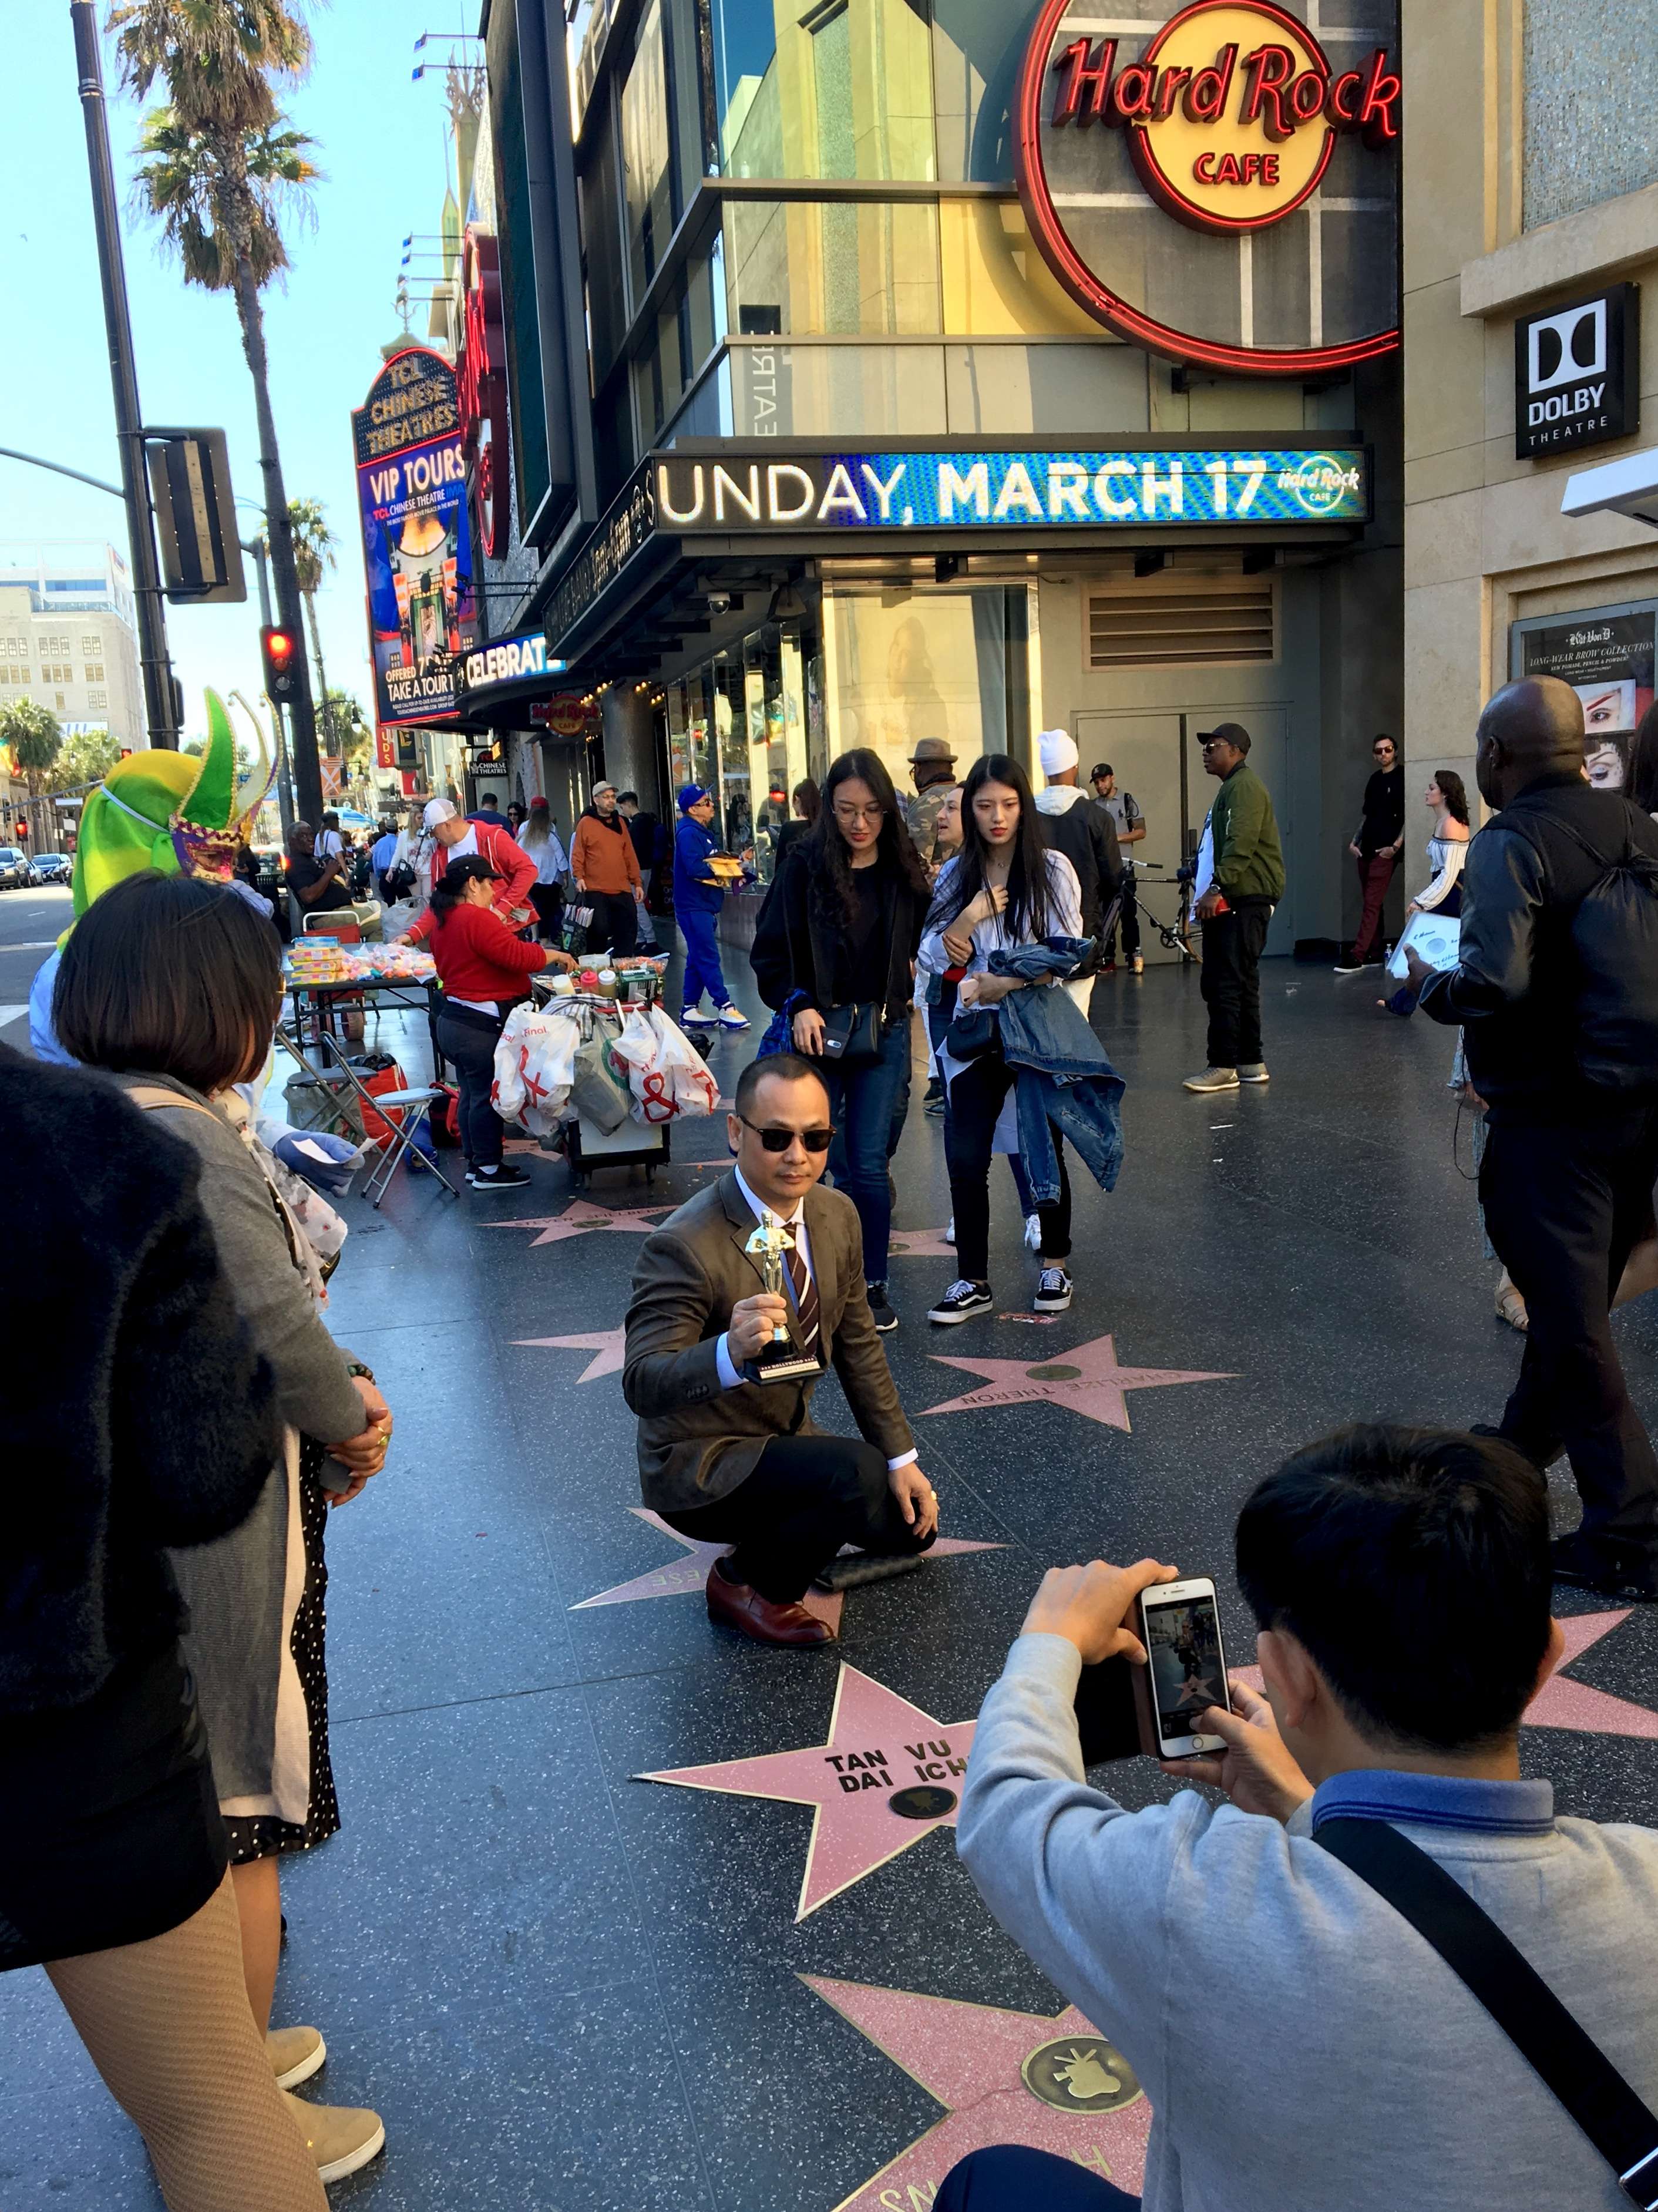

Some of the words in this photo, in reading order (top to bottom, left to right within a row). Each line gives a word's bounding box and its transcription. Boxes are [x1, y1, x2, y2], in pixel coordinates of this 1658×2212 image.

[1053, 37, 1239, 127] Hard
[1237, 43, 1401, 150] Rock
[1193, 152, 1280, 187] CAFE
[387, 357, 423, 389] TCL
[371, 375, 448, 425] CHINESE
[1528, 382, 1607, 427] DOLBY
[365, 403, 457, 455] THEATRES
[1529, 415, 1608, 446] THEATRE
[369, 467, 400, 504] VIP
[403, 443, 466, 494] TOURS
[939, 460, 1184, 517] MARCH
[1206, 459, 1267, 513] 17
[1320, 467, 1360, 490] Rock
[373, 507, 391, 521] TCL
[390, 497, 416, 516] CHINESE
[416, 489, 446, 507] THEATRE
[446, 483, 465, 498] IMA
[385, 665, 416, 683] OFFERED
[418, 657, 425, 677] 7
[1530, 653, 1574, 667] LONG-WEAR
[1575, 648, 1600, 661] BROW
[1601, 641, 1654, 656] COLLECTION
[387, 681, 412, 702] TAKE
[413, 680, 421, 698] A
[421, 675, 449, 696] TOUR
[961, 1387, 1057, 1404] THERON
[825, 1749, 889, 1772] TAN
[904, 1739, 952, 1760] VU
[838, 1769, 894, 1793] DAI
[914, 1756, 969, 1782] ICH
